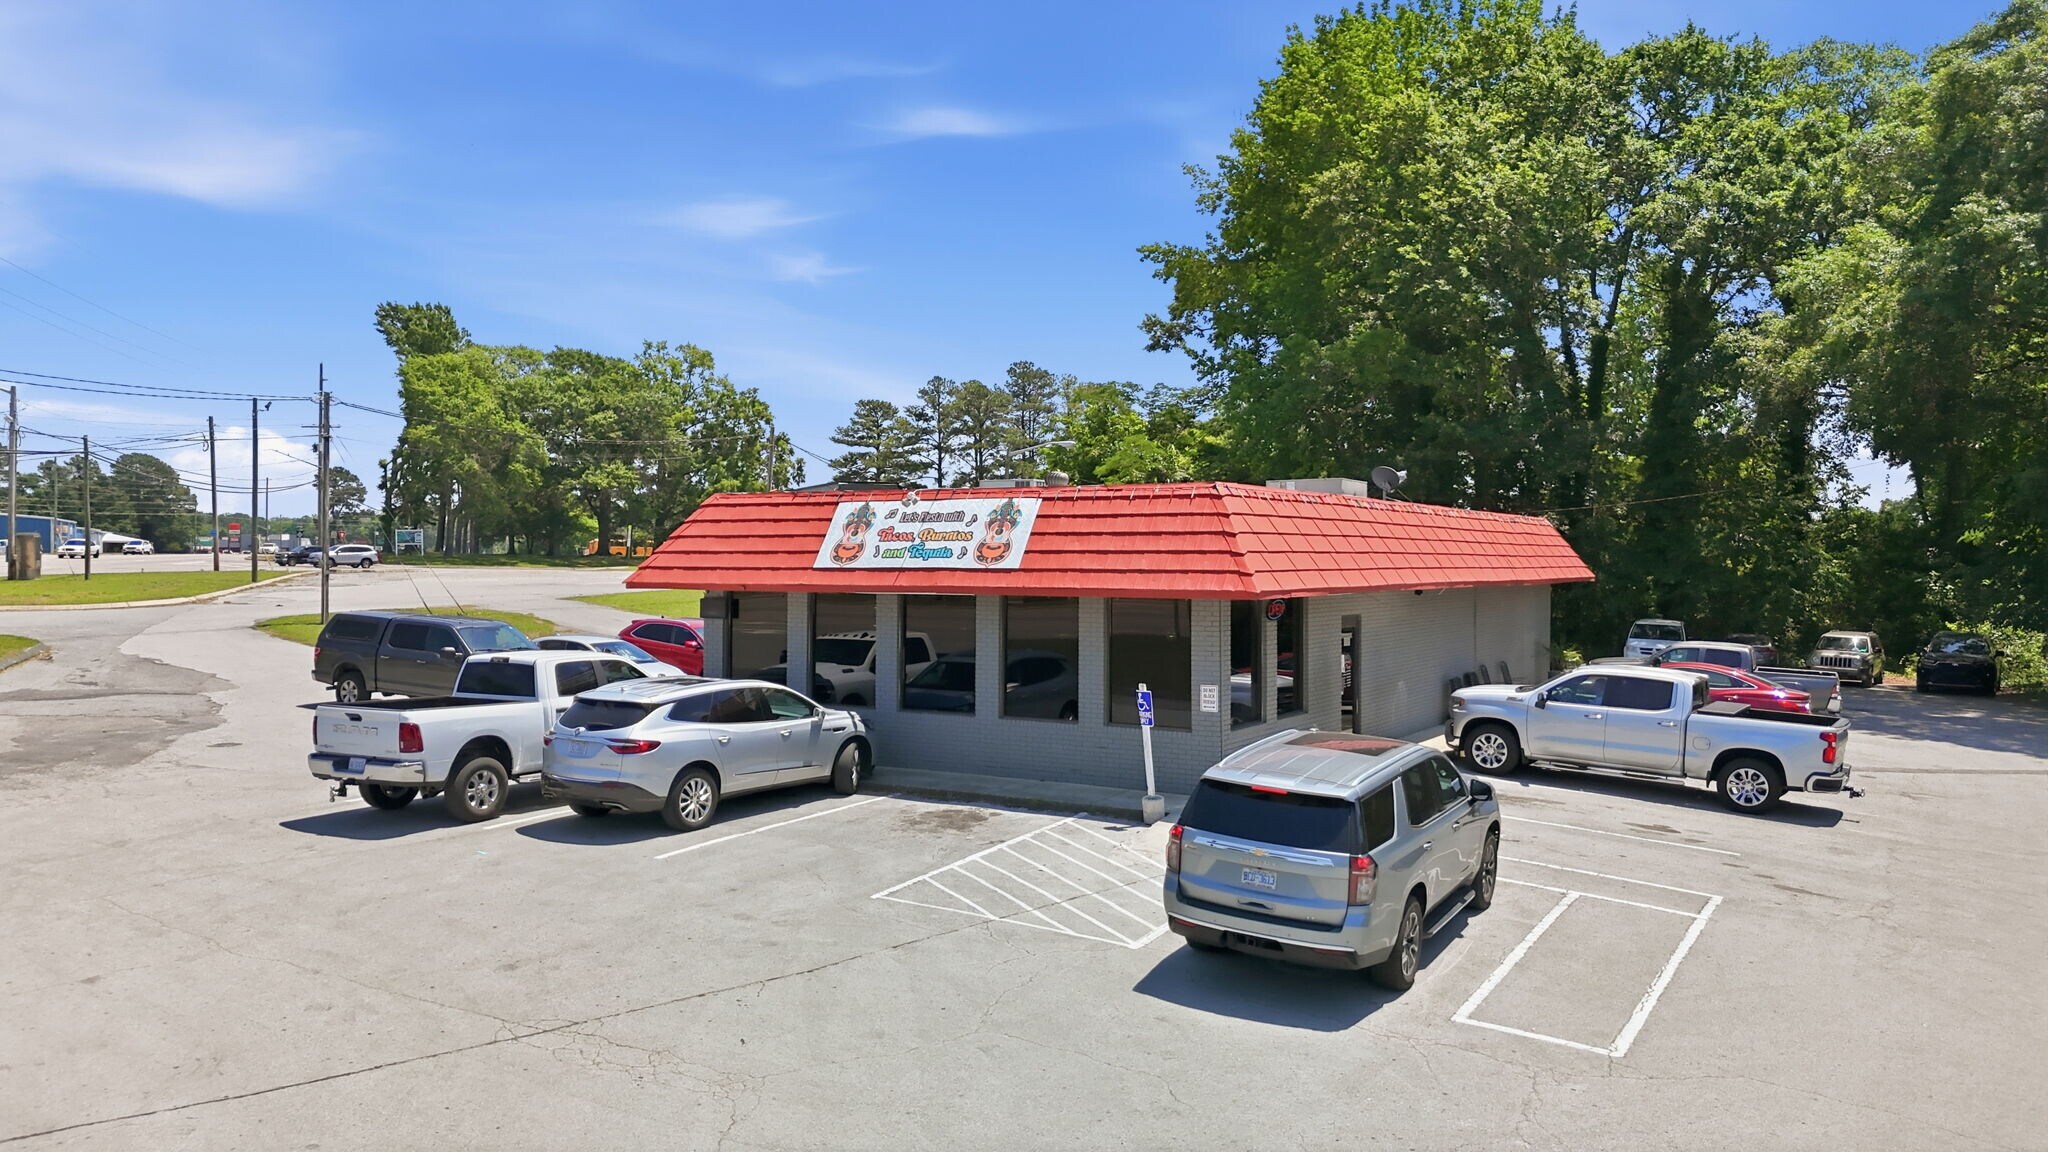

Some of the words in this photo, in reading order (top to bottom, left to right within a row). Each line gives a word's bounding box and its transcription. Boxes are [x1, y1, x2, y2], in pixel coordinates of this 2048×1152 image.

[899, 512, 919, 523] Let's
[919, 511, 944, 523] Fiesta
[944, 510, 965, 522] with
[878, 525, 915, 542] Tacos,
[918, 528, 973, 542] Burritos
[882, 547, 907, 559] and
[908, 542, 953, 561] Tequila
[332, 724, 379, 736] RAM
